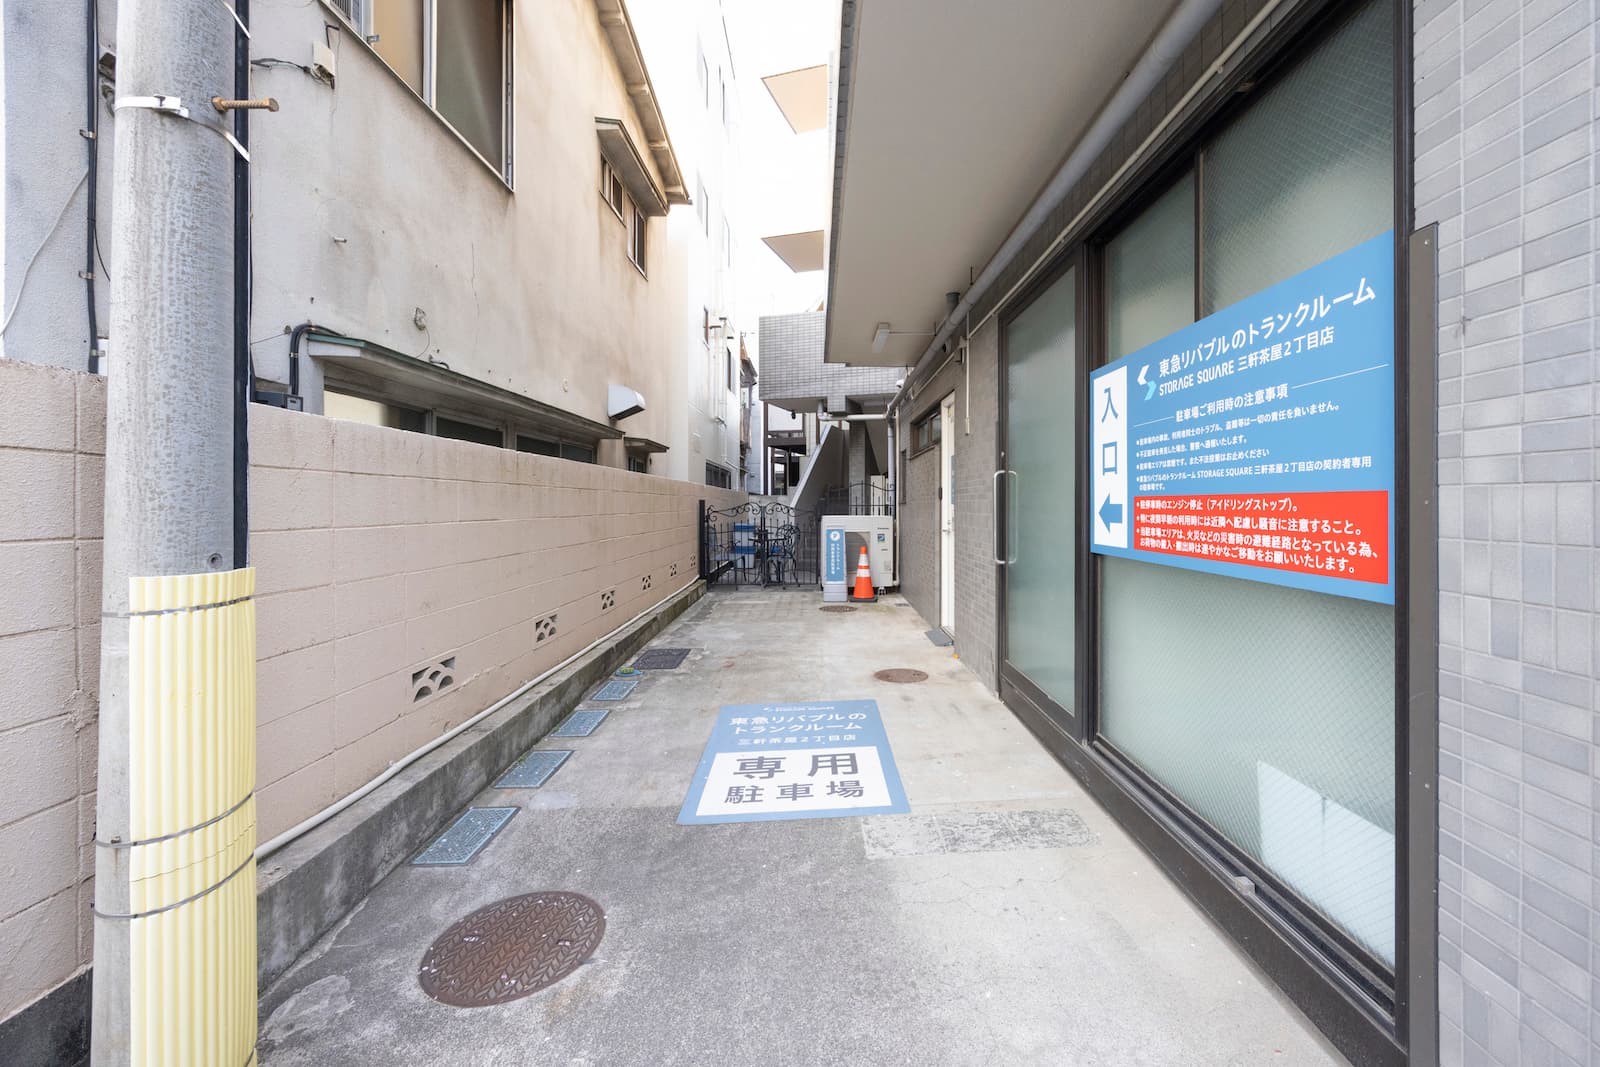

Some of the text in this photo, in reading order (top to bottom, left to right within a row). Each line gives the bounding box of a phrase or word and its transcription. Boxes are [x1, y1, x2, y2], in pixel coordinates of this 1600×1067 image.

[1159, 277, 1377, 378] 東急リバブルのトランクルーム
[1159, 326, 1334, 397] STORAGE SQUARE 三軒茶屋2丁目店
[1176, 383, 1288, 423] 駐車場ご利用時の注意事項
[1101, 387, 1119, 477] 入口
[1196, 467, 1224, 479] STORAGE
[1225, 465, 1253, 477] SQUARE
[729, 712, 867, 726] 東急リバブルの
[734, 722, 863, 735] トランクルーム
[733, 752, 859, 780] 専用
[724, 780, 864, 805] 駐車場
